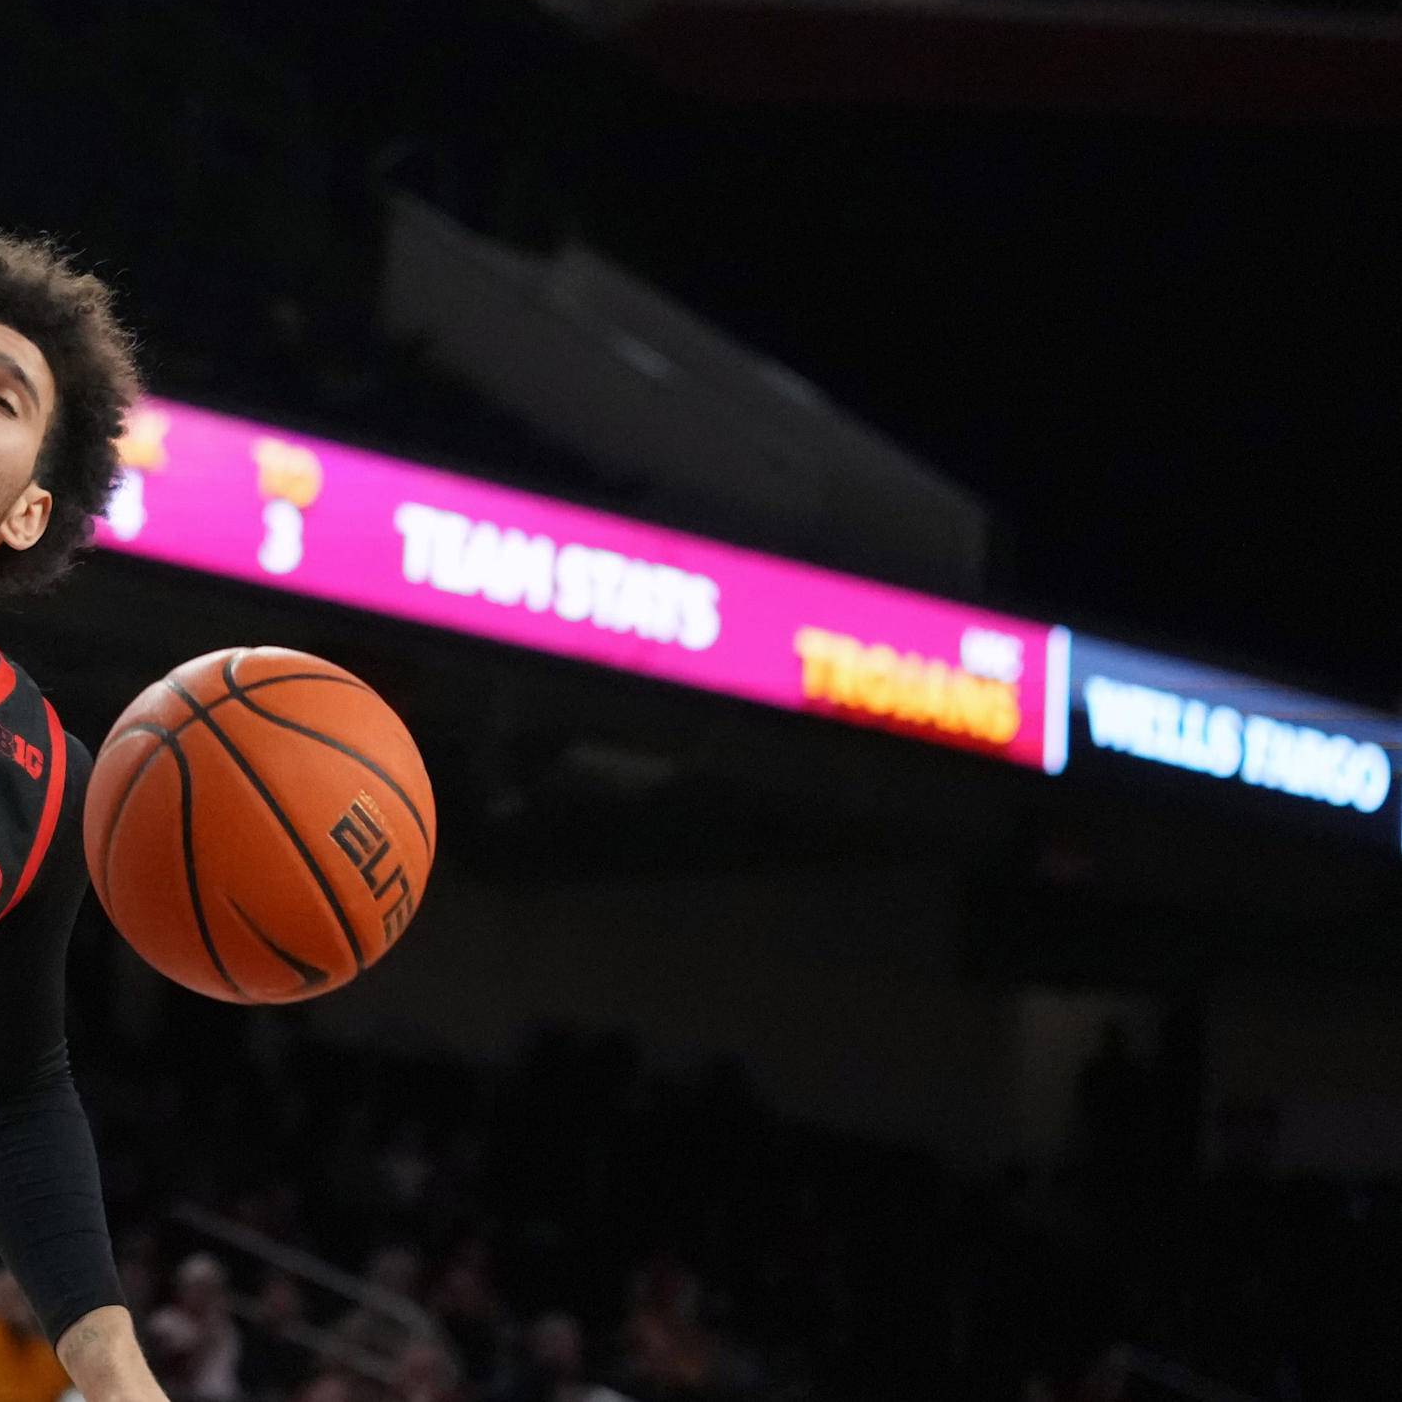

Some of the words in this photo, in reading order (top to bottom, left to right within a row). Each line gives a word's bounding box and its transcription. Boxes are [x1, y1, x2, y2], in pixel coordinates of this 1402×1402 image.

[393, 500, 557, 613] TEAM
[556, 542, 721, 651] STATS
[1083, 674, 1244, 778] WELLS
[327, 799, 413, 945] ELITE
